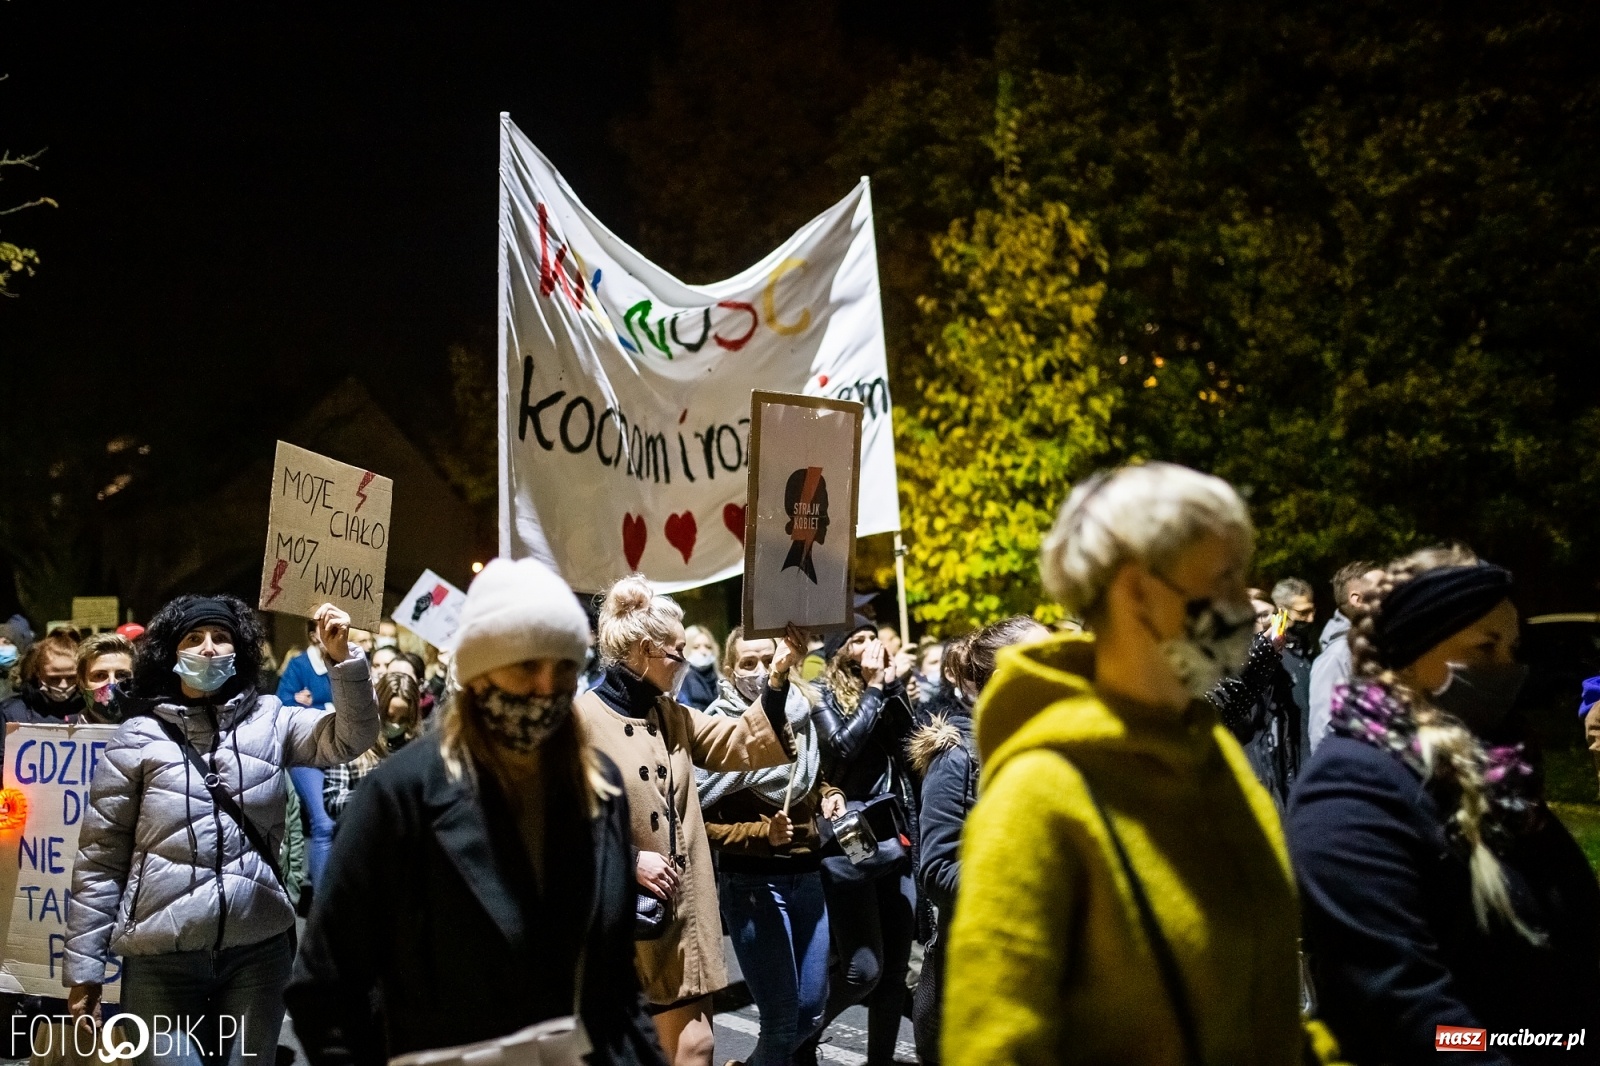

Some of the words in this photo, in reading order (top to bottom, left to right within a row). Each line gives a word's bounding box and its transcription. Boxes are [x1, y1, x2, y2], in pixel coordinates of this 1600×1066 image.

[679, 409, 696, 483] i
[794, 503, 820, 515] STRAJK
[794, 517, 818, 529] KOBIET
[330, 510, 385, 549] CIAŁO
[314, 563, 374, 603] WYBÓR
[18, 836, 65, 874] NIE
